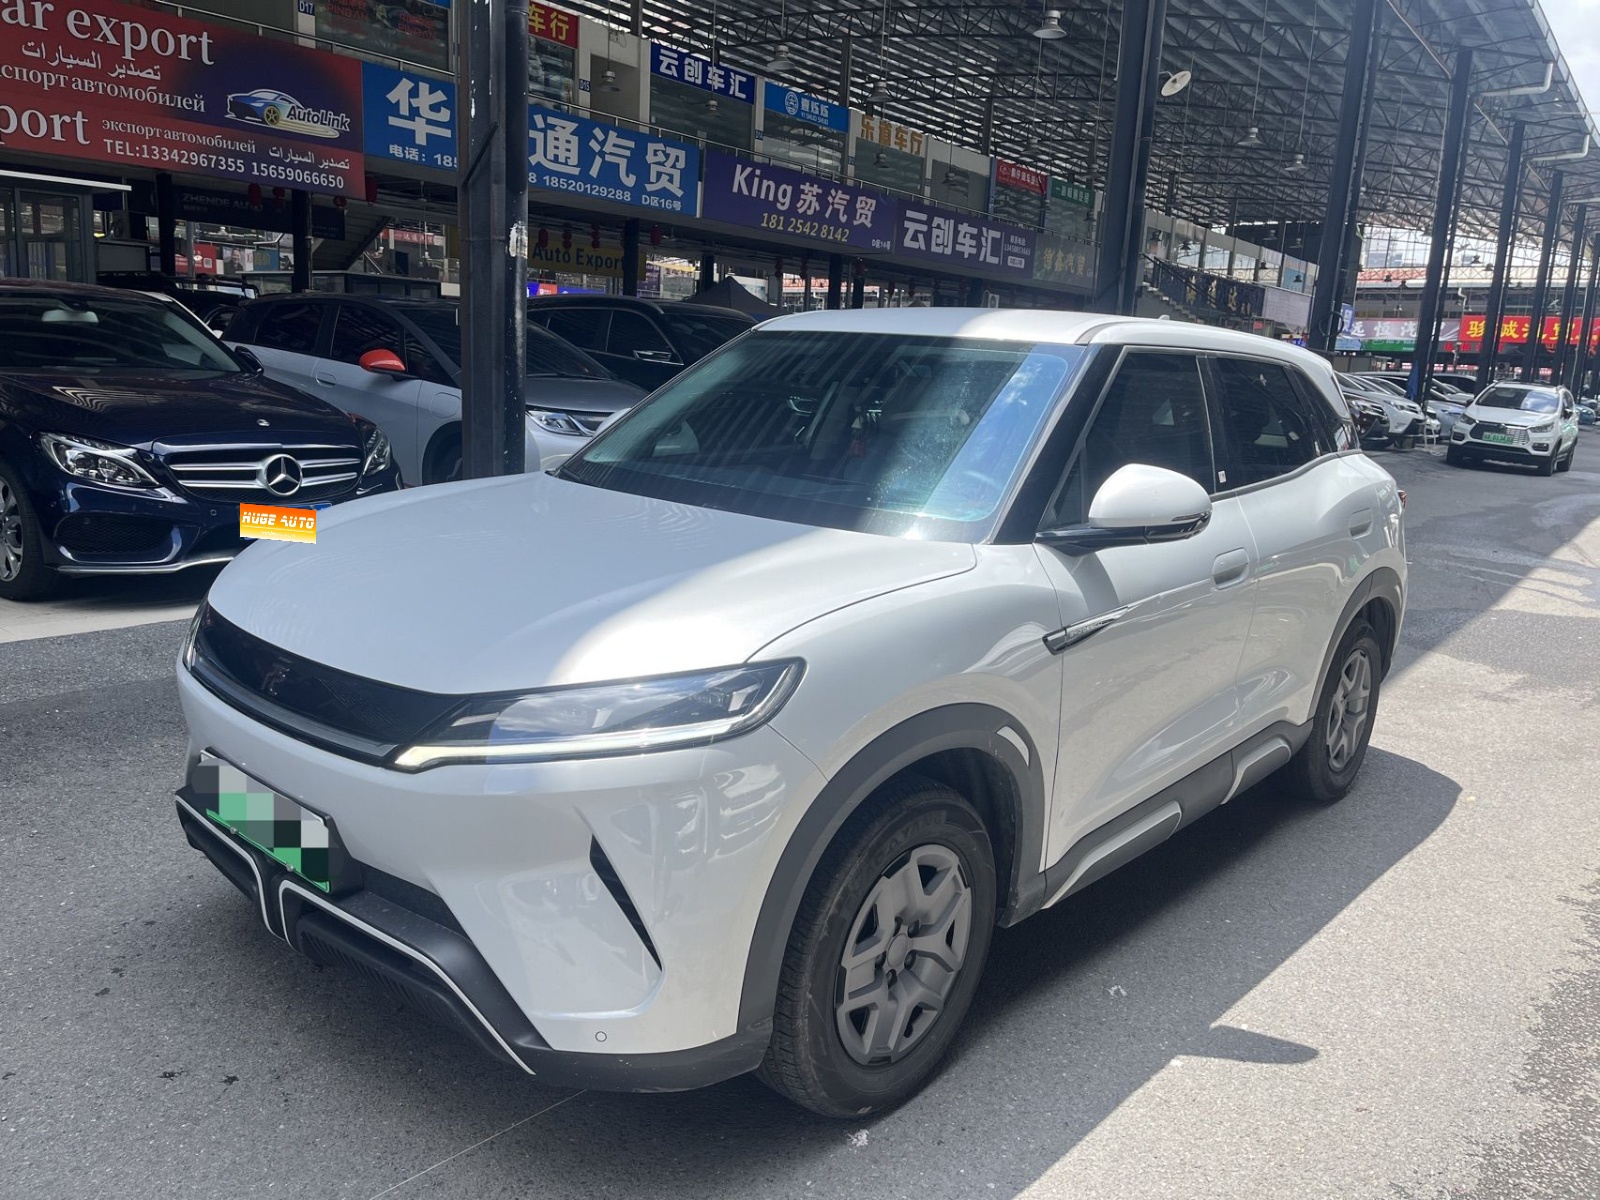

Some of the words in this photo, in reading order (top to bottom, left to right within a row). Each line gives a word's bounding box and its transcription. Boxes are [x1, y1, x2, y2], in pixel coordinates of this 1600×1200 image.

[66, 9, 215, 66] export
[22, 41, 102, 70] السيارات
[108, 63, 161, 80] تصدير
[659, 48, 747, 99] 云创车汇
[0, 64, 68, 91] спорт
[72, 77, 206, 113] автомобилей
[285, 104, 350, 131] AutoLink
[102, 119, 163, 140] экспорт
[164, 129, 256, 154] автомобилей
[103, 138, 245, 173] TEL:13342967355
[251, 162, 345, 189] 15659066650
[268, 146, 315, 165] السيارات
[318, 157, 350, 170] تصدير
[543, 175, 631, 201] 18520129288
[642, 195, 682, 211] D区16号
[761, 212, 784, 230] 181
[787, 217, 819, 236] 2542
[820, 224, 850, 243] 8142
[903, 209, 1002, 265] 云创车汇
[532, 244, 571, 263] Auto
